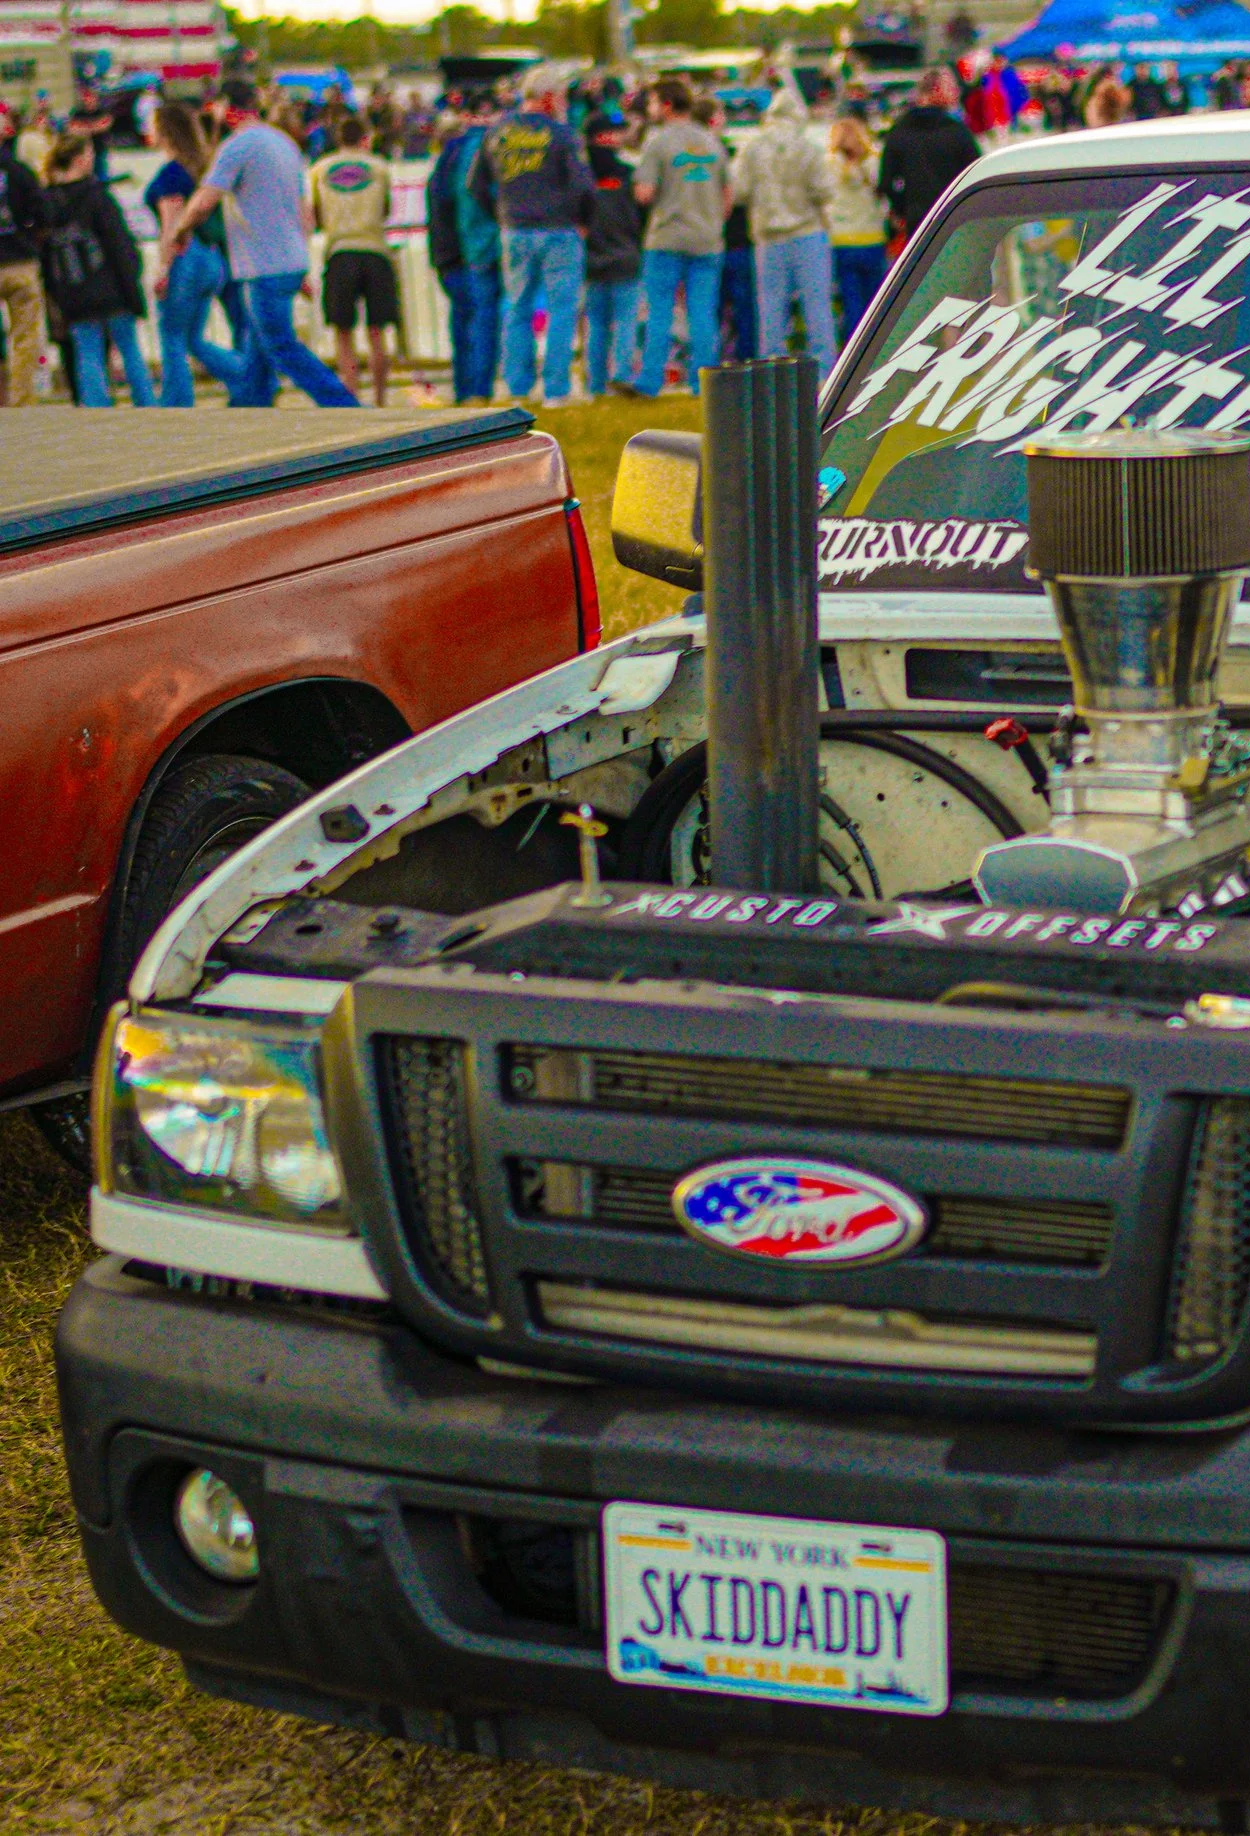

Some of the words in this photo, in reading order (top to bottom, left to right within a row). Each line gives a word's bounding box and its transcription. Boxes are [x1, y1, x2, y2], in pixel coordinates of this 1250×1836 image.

[965, 910, 1217, 951] OFFSETS
[721, 1180, 857, 1243] Ford
[695, 1533, 760, 1561] NEW
[770, 1540, 850, 1569] YORK
[639, 1568, 911, 1660] SKIDDADDY
